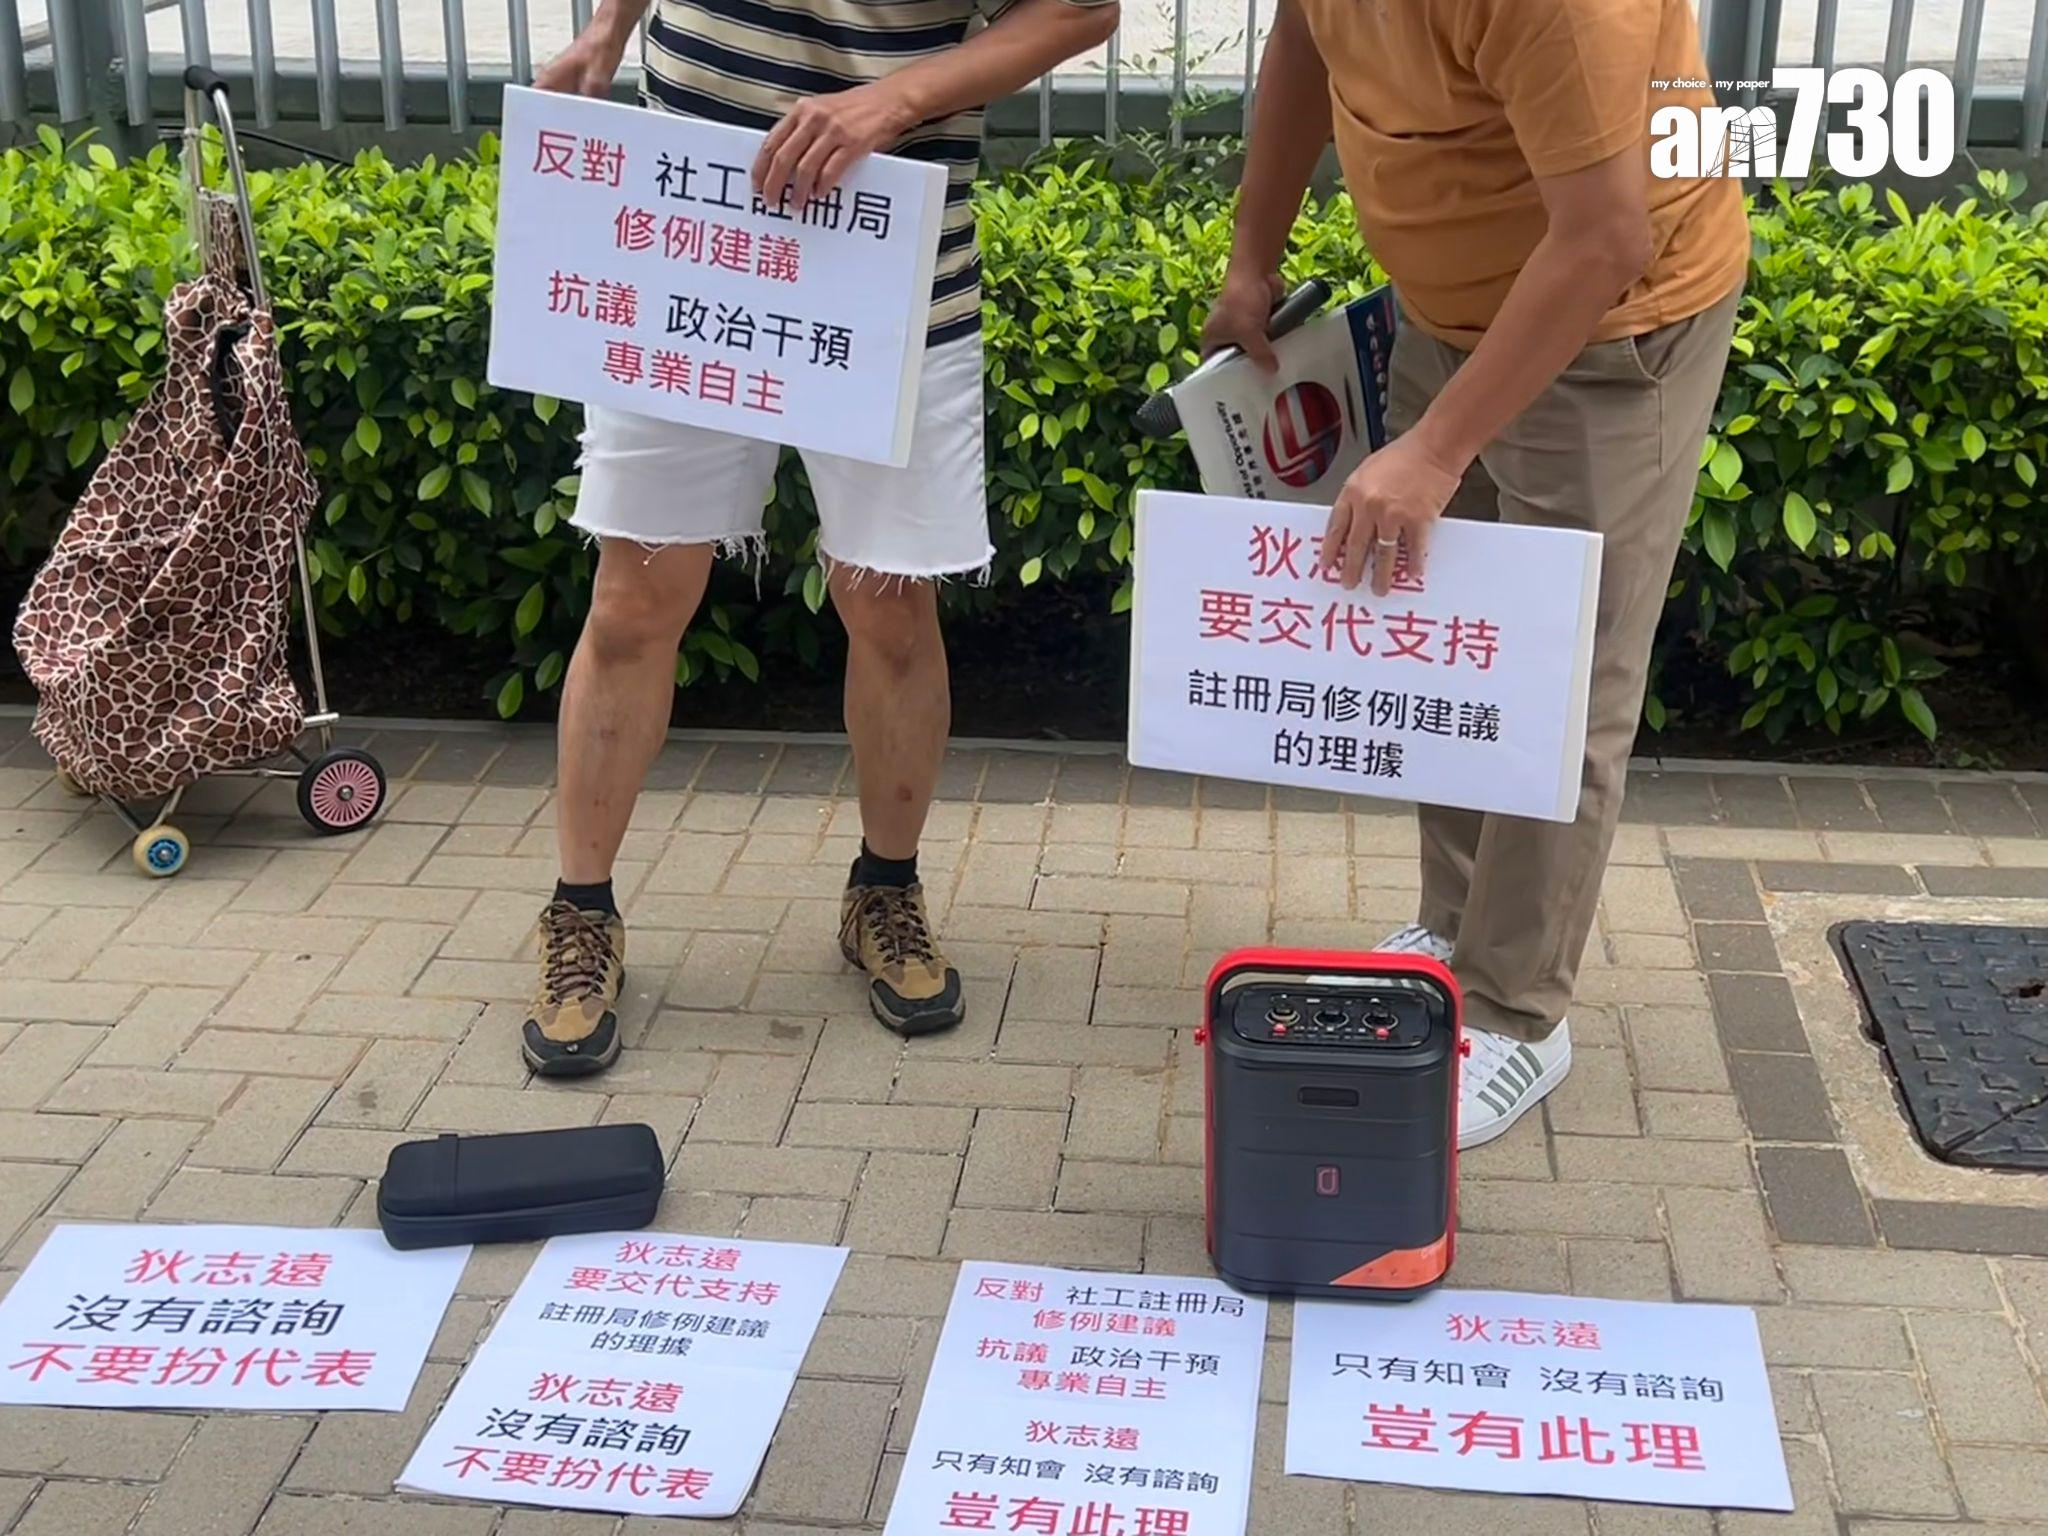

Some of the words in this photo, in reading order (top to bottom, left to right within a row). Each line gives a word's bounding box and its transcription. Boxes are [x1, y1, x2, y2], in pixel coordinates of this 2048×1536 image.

[533, 130, 626, 188] 反對
[614, 205, 801, 284] 修例建議
[548, 270, 638, 329] 抗議
[665, 294, 853, 371] 政治干預
[602, 340, 785, 415] 專業自主
[1216, 400, 1244, 466] Opportunity
[1199, 588, 1500, 670] 要交代支持
[1188, 668, 1501, 743] 註冊局修例建議
[1272, 727, 1405, 779] 的理據
[123, 1248, 333, 1288] 狄志遠
[614, 1240, 742, 1271] 狄志遠
[563, 1265, 781, 1306] 要交代支持
[973, 1277, 1044, 1304] 反對
[1065, 1285, 1246, 1318] 社工註冊局
[52, 1293, 346, 1336] 沒有諮詢
[538, 1302, 771, 1339] 註冊局修例建議
[1032, 1308, 1179, 1338] 修例建議
[1445, 1312, 1602, 1350] 狄志遠
[7, 1342, 378, 1387] 不要扮代表
[590, 1330, 695, 1357] 的理據
[976, 1336, 1051, 1365] 抗議
[1069, 1345, 1222, 1377] 政治干預
[528, 1372, 685, 1414] 狄志遠
[1016, 1369, 1168, 1400] 專業自主
[1331, 1352, 1512, 1388] 只有知會
[1539, 1365, 1725, 1403] 沒有諮詢
[475, 1406, 692, 1456] 沒有諮詢
[1025, 1420, 1141, 1451] 狄志遠
[1361, 1403, 1706, 1472] 豈有此理
[443, 1445, 715, 1501] 不要扮代表
[931, 1450, 1067, 1481] 只有知會
[1083, 1462, 1220, 1495] 沒有諮詢
[940, 1491, 1190, 1536] 豈有此理
